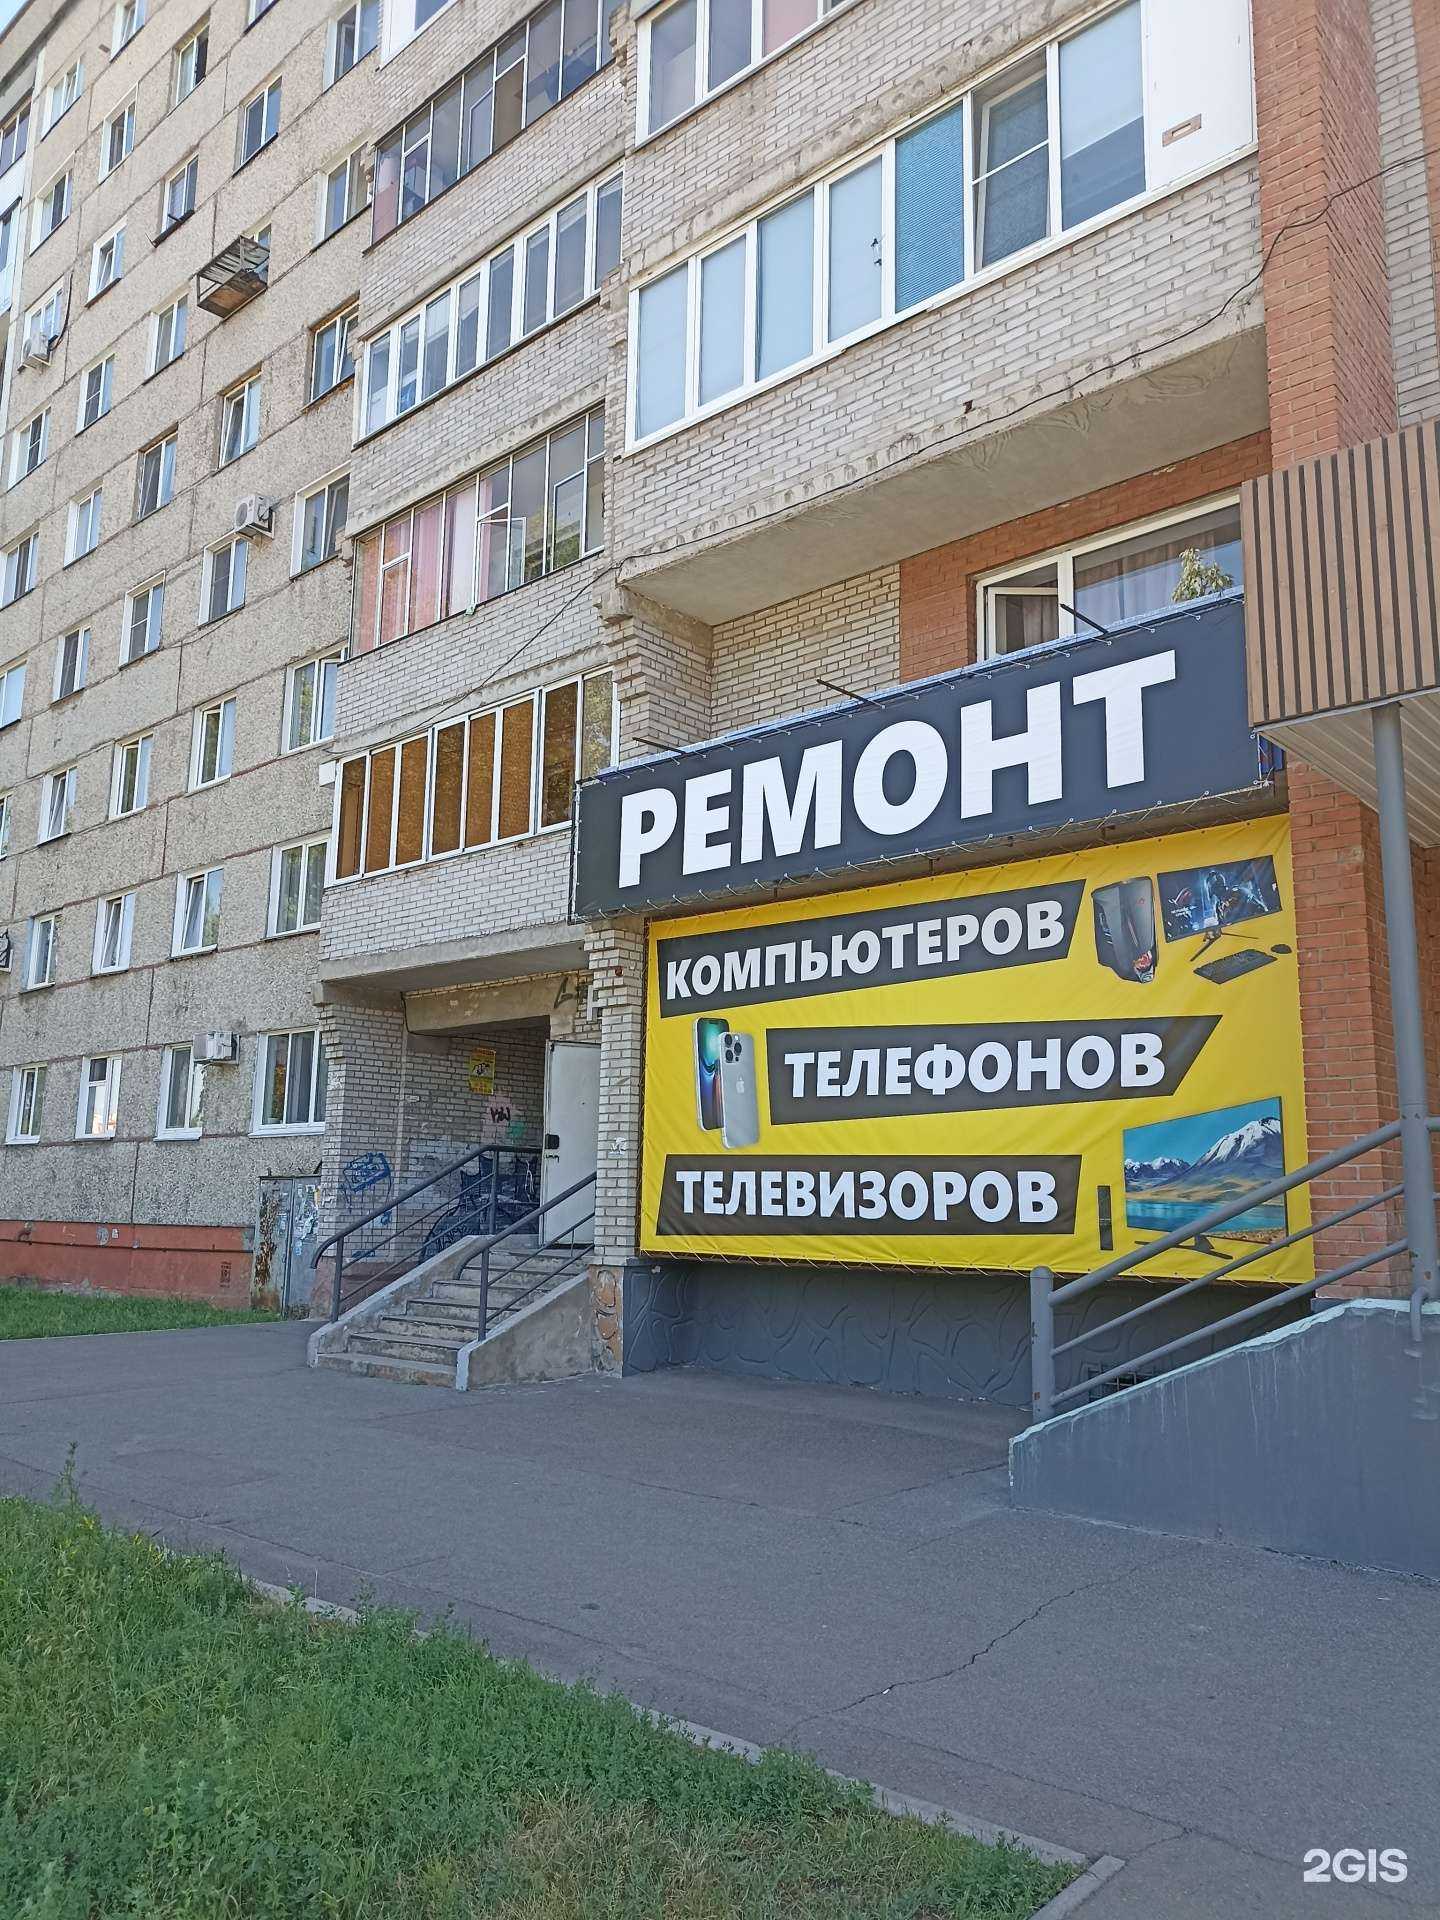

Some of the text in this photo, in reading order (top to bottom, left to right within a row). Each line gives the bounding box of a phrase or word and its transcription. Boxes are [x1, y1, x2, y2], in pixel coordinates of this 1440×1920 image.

[619, 650, 1176, 889] РЕМОНТ
[666, 900, 1065, 1000] КОМПЬЮТЕРОВ
[784, 1032, 1165, 1098] ТЕЛЕФОНОВ
[675, 1170, 1059, 1223] ТЕЛЕВИЗОРОВ
